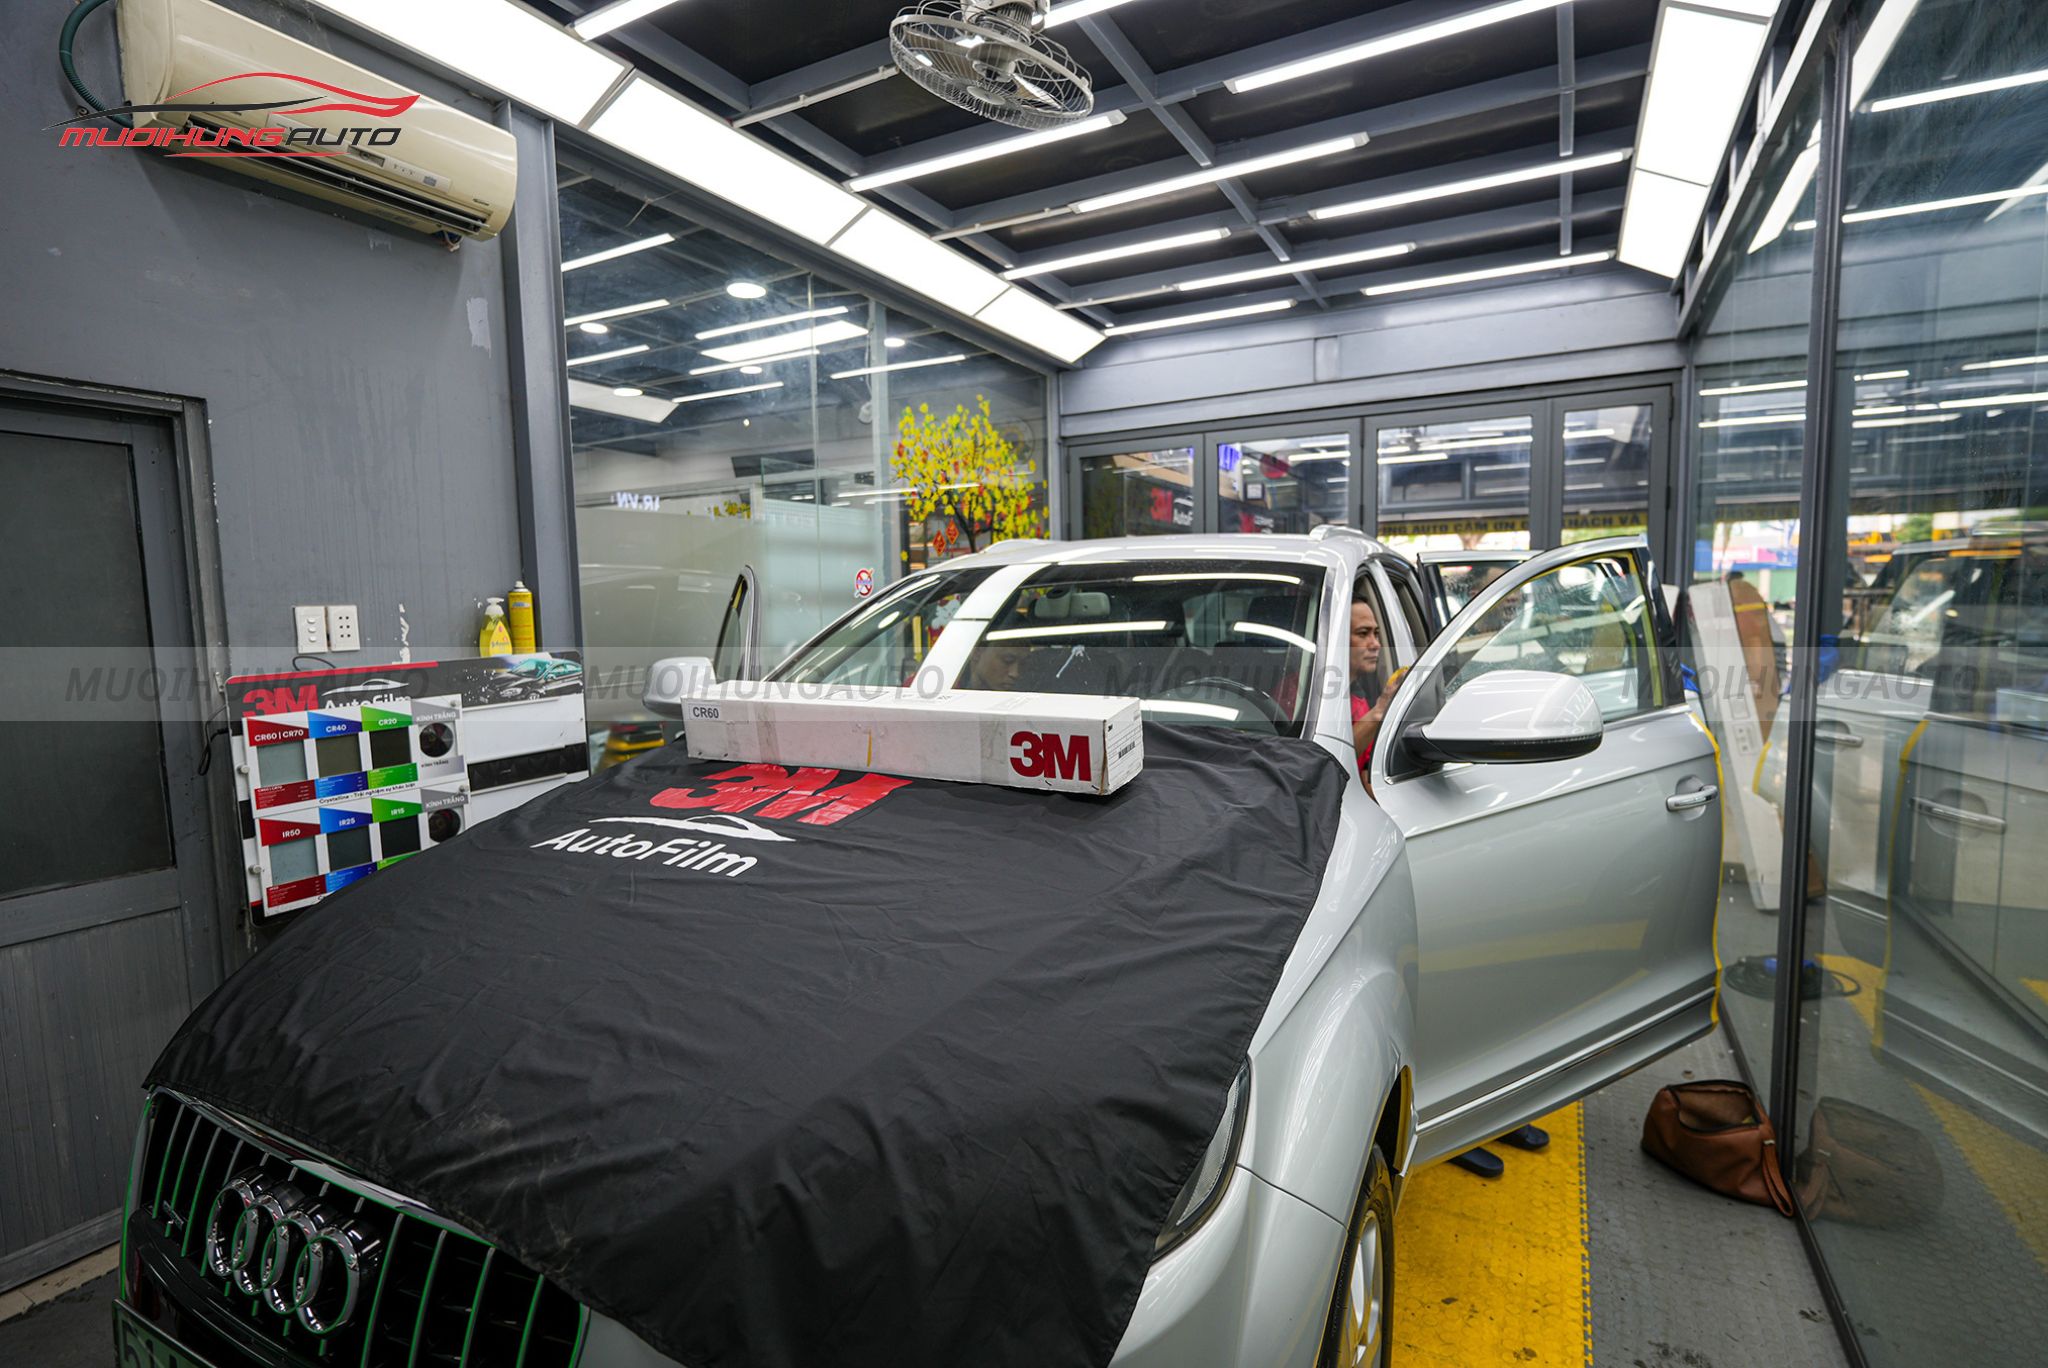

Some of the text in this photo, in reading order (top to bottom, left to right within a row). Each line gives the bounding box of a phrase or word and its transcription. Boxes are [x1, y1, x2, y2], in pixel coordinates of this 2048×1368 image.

[242, 684, 319, 717] 3M
[692, 706, 720, 719] CR60
[325, 723, 347, 733] CR40
[378, 717, 397, 727] CR20
[254, 732, 278, 742] CR60
[282, 728, 304, 739] CR70
[1009, 731, 1092, 781] 3M
[649, 763, 914, 826] 3M
[390, 806, 405, 816] IR15
[338, 817, 356, 827] IR25
[282, 828, 301, 839] IR50
[529, 827, 758, 878] AutoFilm
